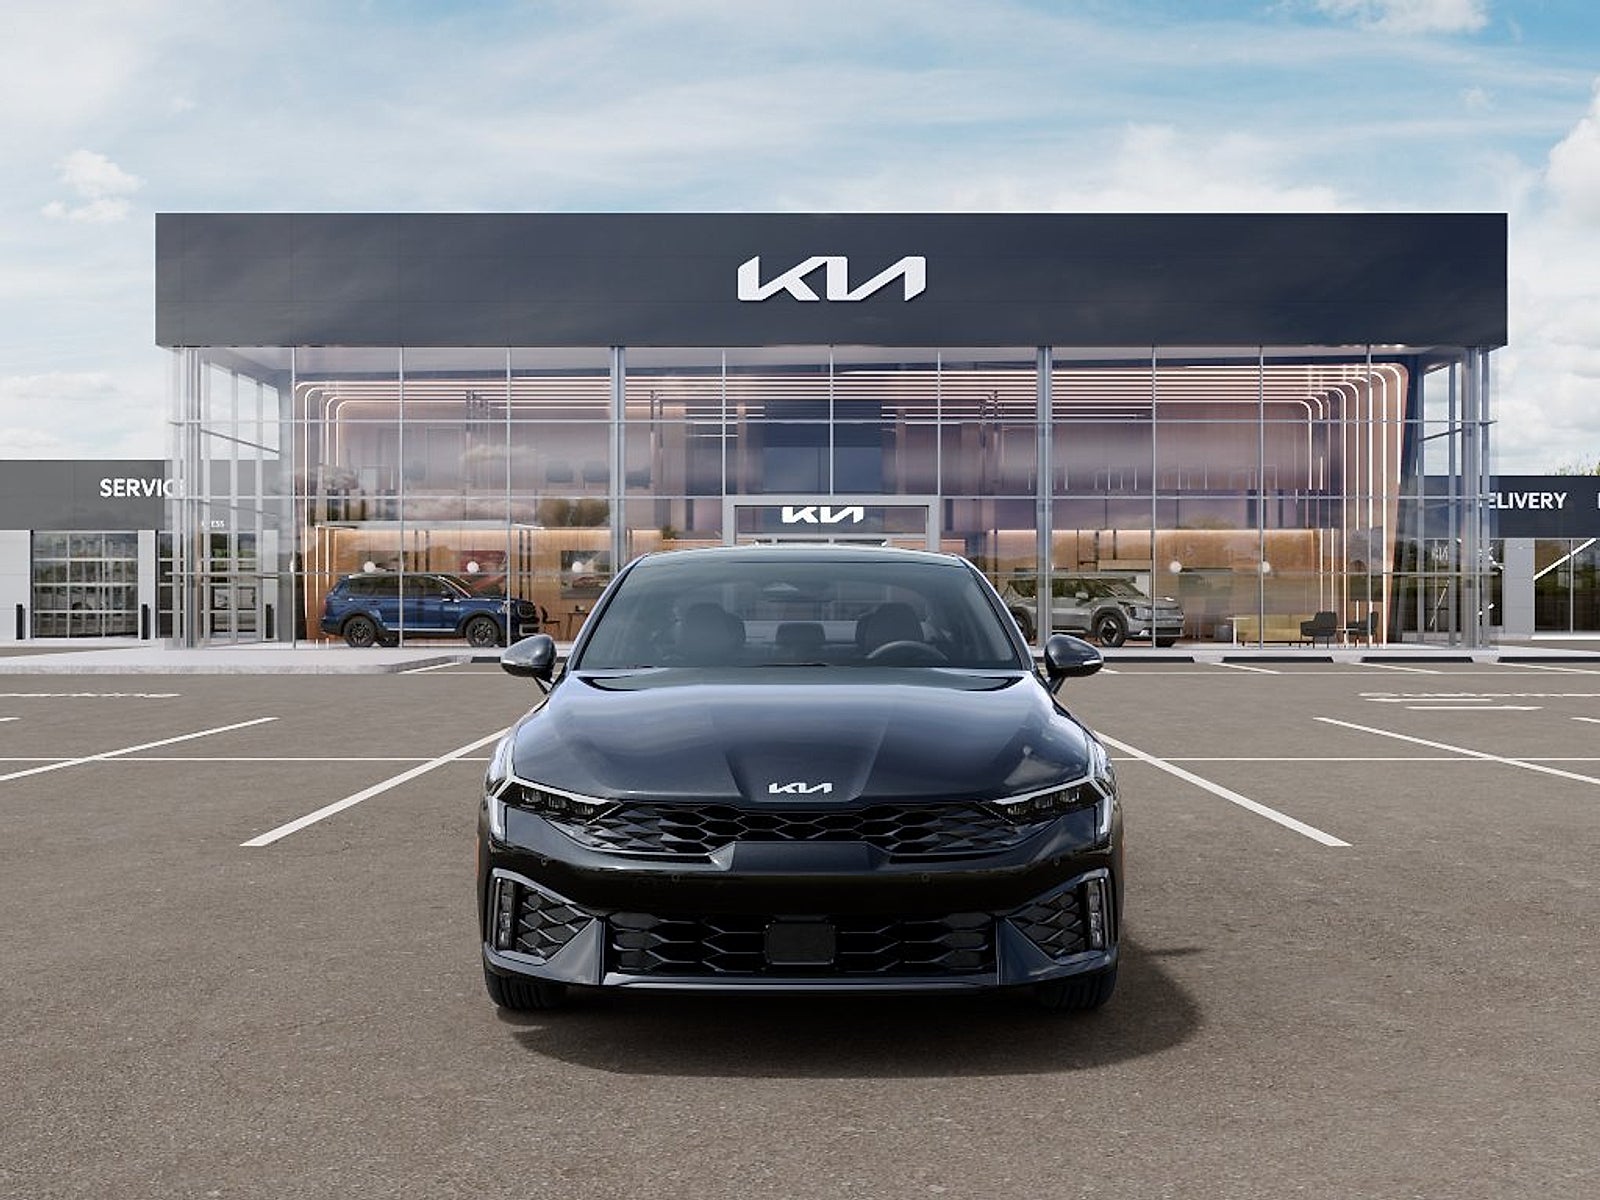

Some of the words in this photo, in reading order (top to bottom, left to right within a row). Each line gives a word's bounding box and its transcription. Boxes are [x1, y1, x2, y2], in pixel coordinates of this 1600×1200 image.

[738, 256, 926, 301] KIA
[100, 478, 184, 497] SERVIC
[781, 506, 864, 523] KIA
[768, 782, 833, 794] KIA
